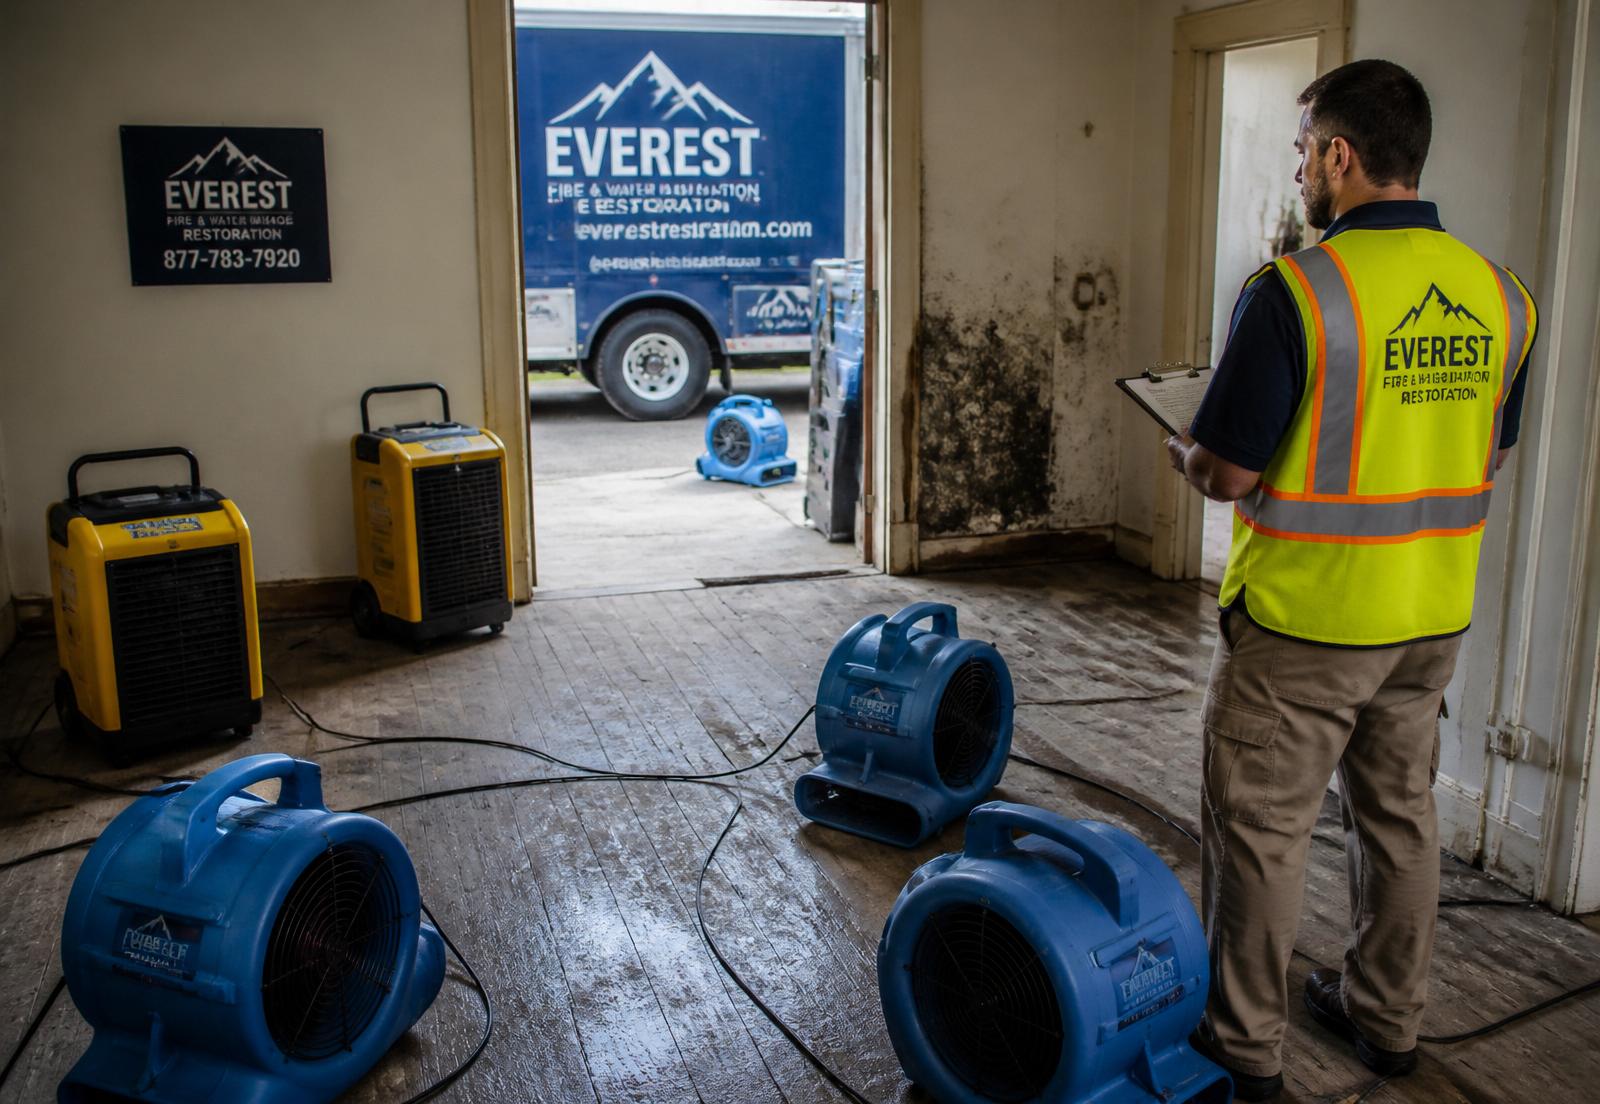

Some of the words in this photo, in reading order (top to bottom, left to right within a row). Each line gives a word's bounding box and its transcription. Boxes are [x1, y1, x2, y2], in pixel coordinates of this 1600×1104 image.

[545, 127, 760, 176] EVEREST
[164, 180, 293, 209] EVEREST
[183, 228, 283, 241] RESTORATION
[163, 248, 301, 269] 877-783-7920
[1384, 334, 1494, 371] EVEREST
